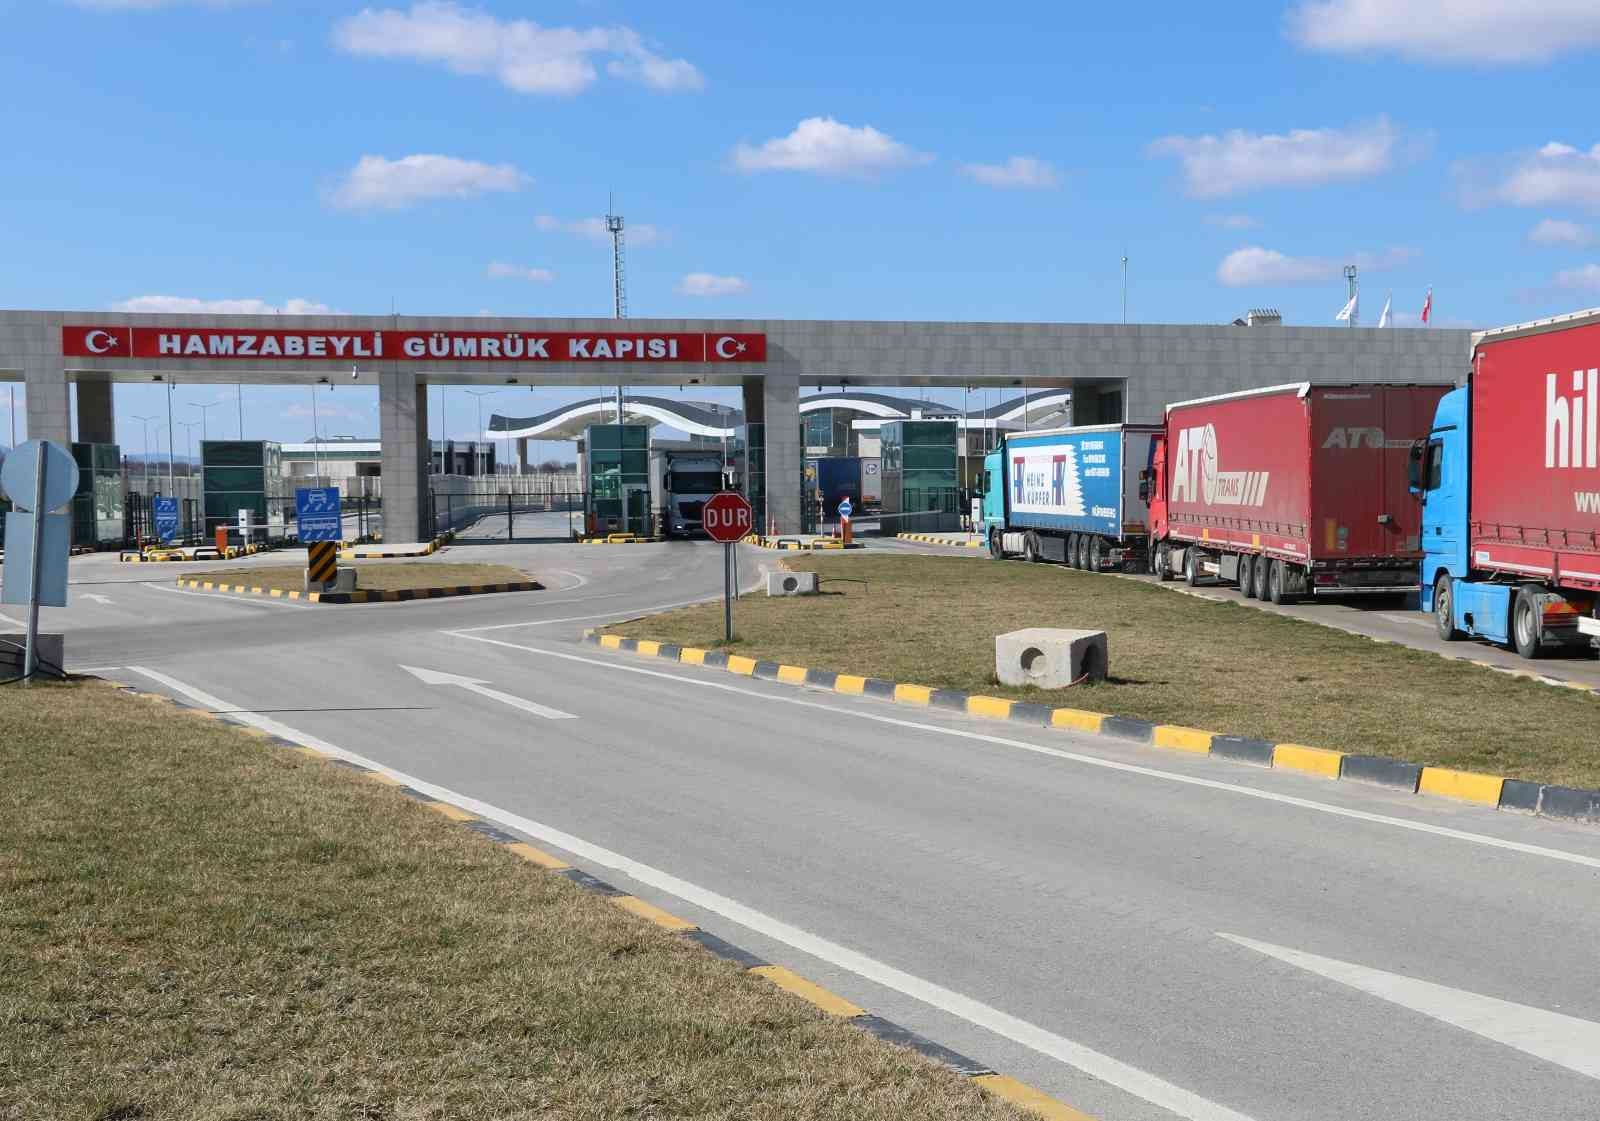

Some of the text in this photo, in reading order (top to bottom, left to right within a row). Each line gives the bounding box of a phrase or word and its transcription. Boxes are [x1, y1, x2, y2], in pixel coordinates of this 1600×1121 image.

[158, 330, 678, 359] HAMZABEYLİ GÜMRÜK KAPISI
[1217, 478, 1240, 497] TRANS
[706, 508, 748, 528] DUR
